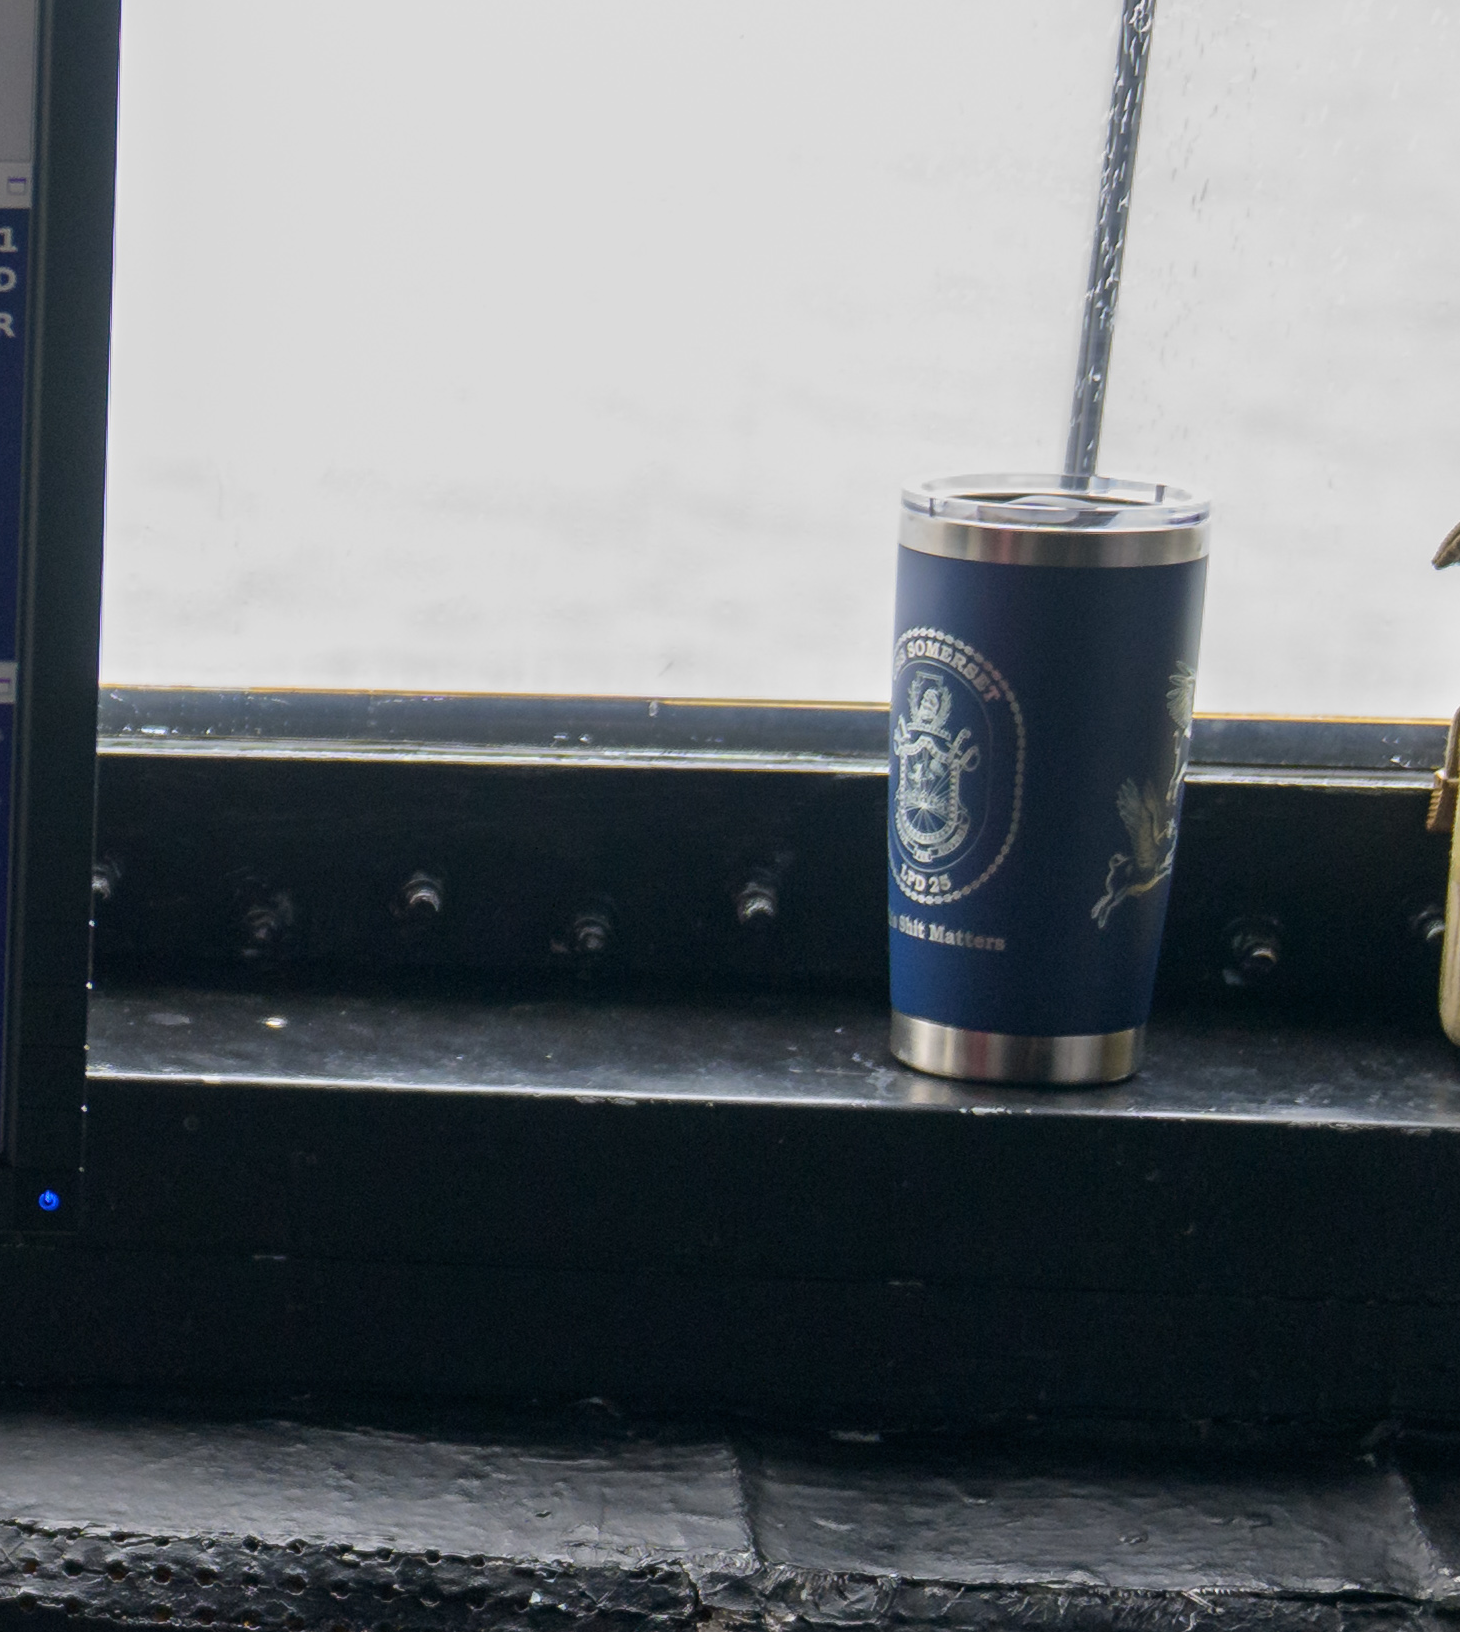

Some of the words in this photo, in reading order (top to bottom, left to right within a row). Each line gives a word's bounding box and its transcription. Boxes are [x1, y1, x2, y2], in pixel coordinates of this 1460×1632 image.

[906, 640, 1000, 702] SOMERSET
[900, 864, 927, 893] LPD
[928, 874, 951, 894] 25
[929, 921, 1006, 951] Matters
